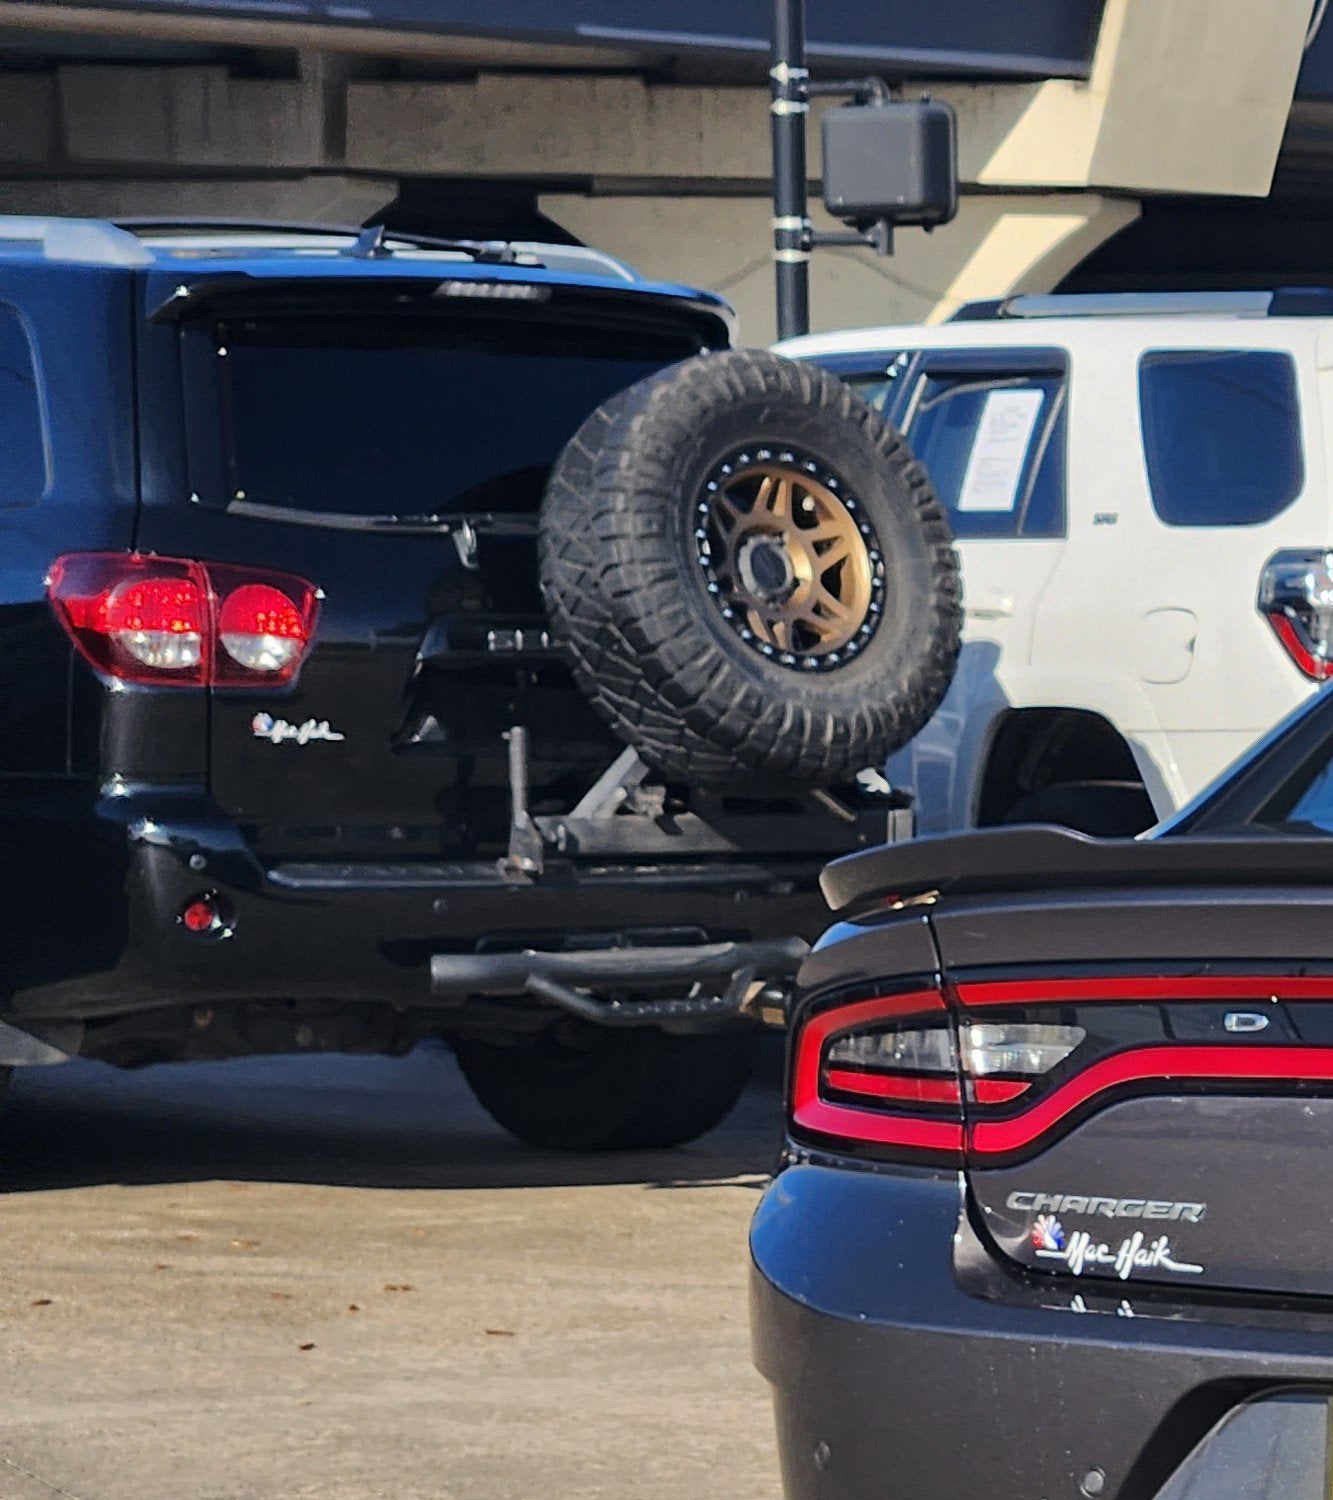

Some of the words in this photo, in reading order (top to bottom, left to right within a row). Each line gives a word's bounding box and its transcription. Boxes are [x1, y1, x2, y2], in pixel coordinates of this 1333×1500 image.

[1006, 1191, 1206, 1223] CHARGER
[1040, 1230, 1116, 1276] Mac
[1114, 1230, 1204, 1280] Haik
